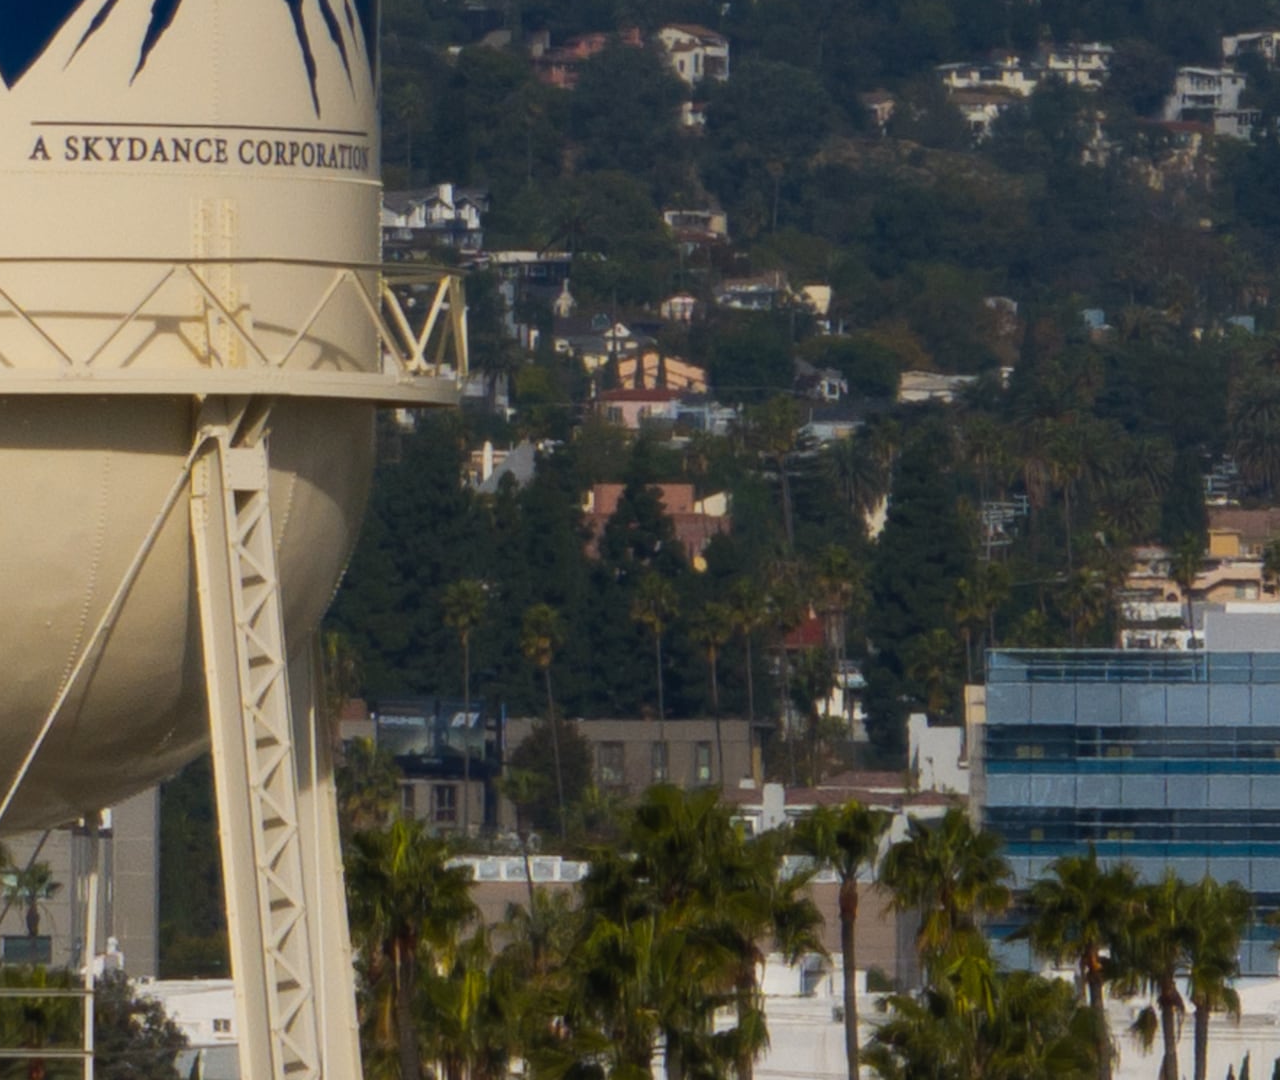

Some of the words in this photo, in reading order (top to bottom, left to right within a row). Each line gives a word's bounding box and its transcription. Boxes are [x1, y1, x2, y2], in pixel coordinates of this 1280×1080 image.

[29, 136, 51, 161] A
[65, 136, 228, 163] SKYDANCE
[238, 139, 370, 169] CORPORATION
